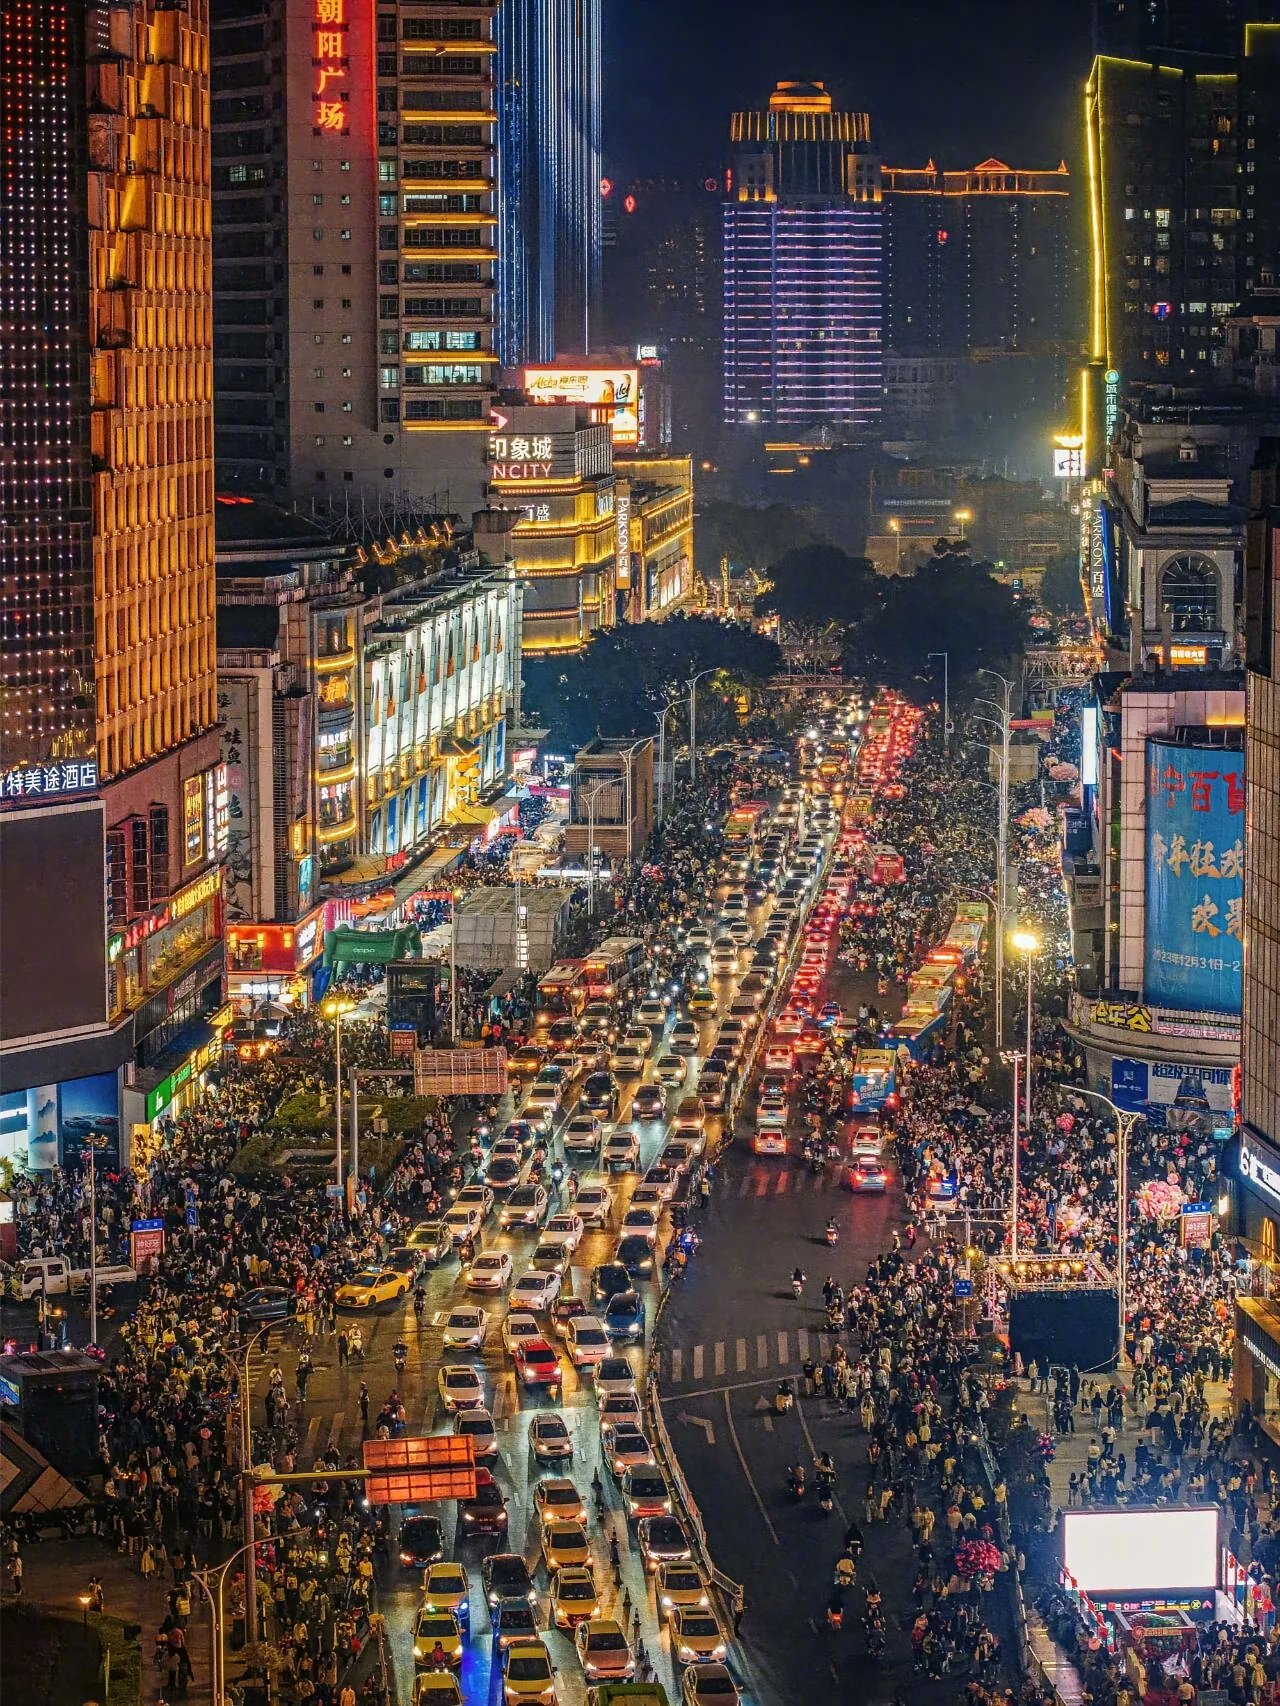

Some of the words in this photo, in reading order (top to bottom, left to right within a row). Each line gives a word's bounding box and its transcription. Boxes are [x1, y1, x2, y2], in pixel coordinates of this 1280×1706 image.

[316, 0, 345, 129] 朝阳广场
[490, 436, 553, 460] 印象城
[618, 497, 629, 554] PARKSON
[1093, 509, 1104, 567] PARKSON
[1092, 571, 1104, 597] 百盛
